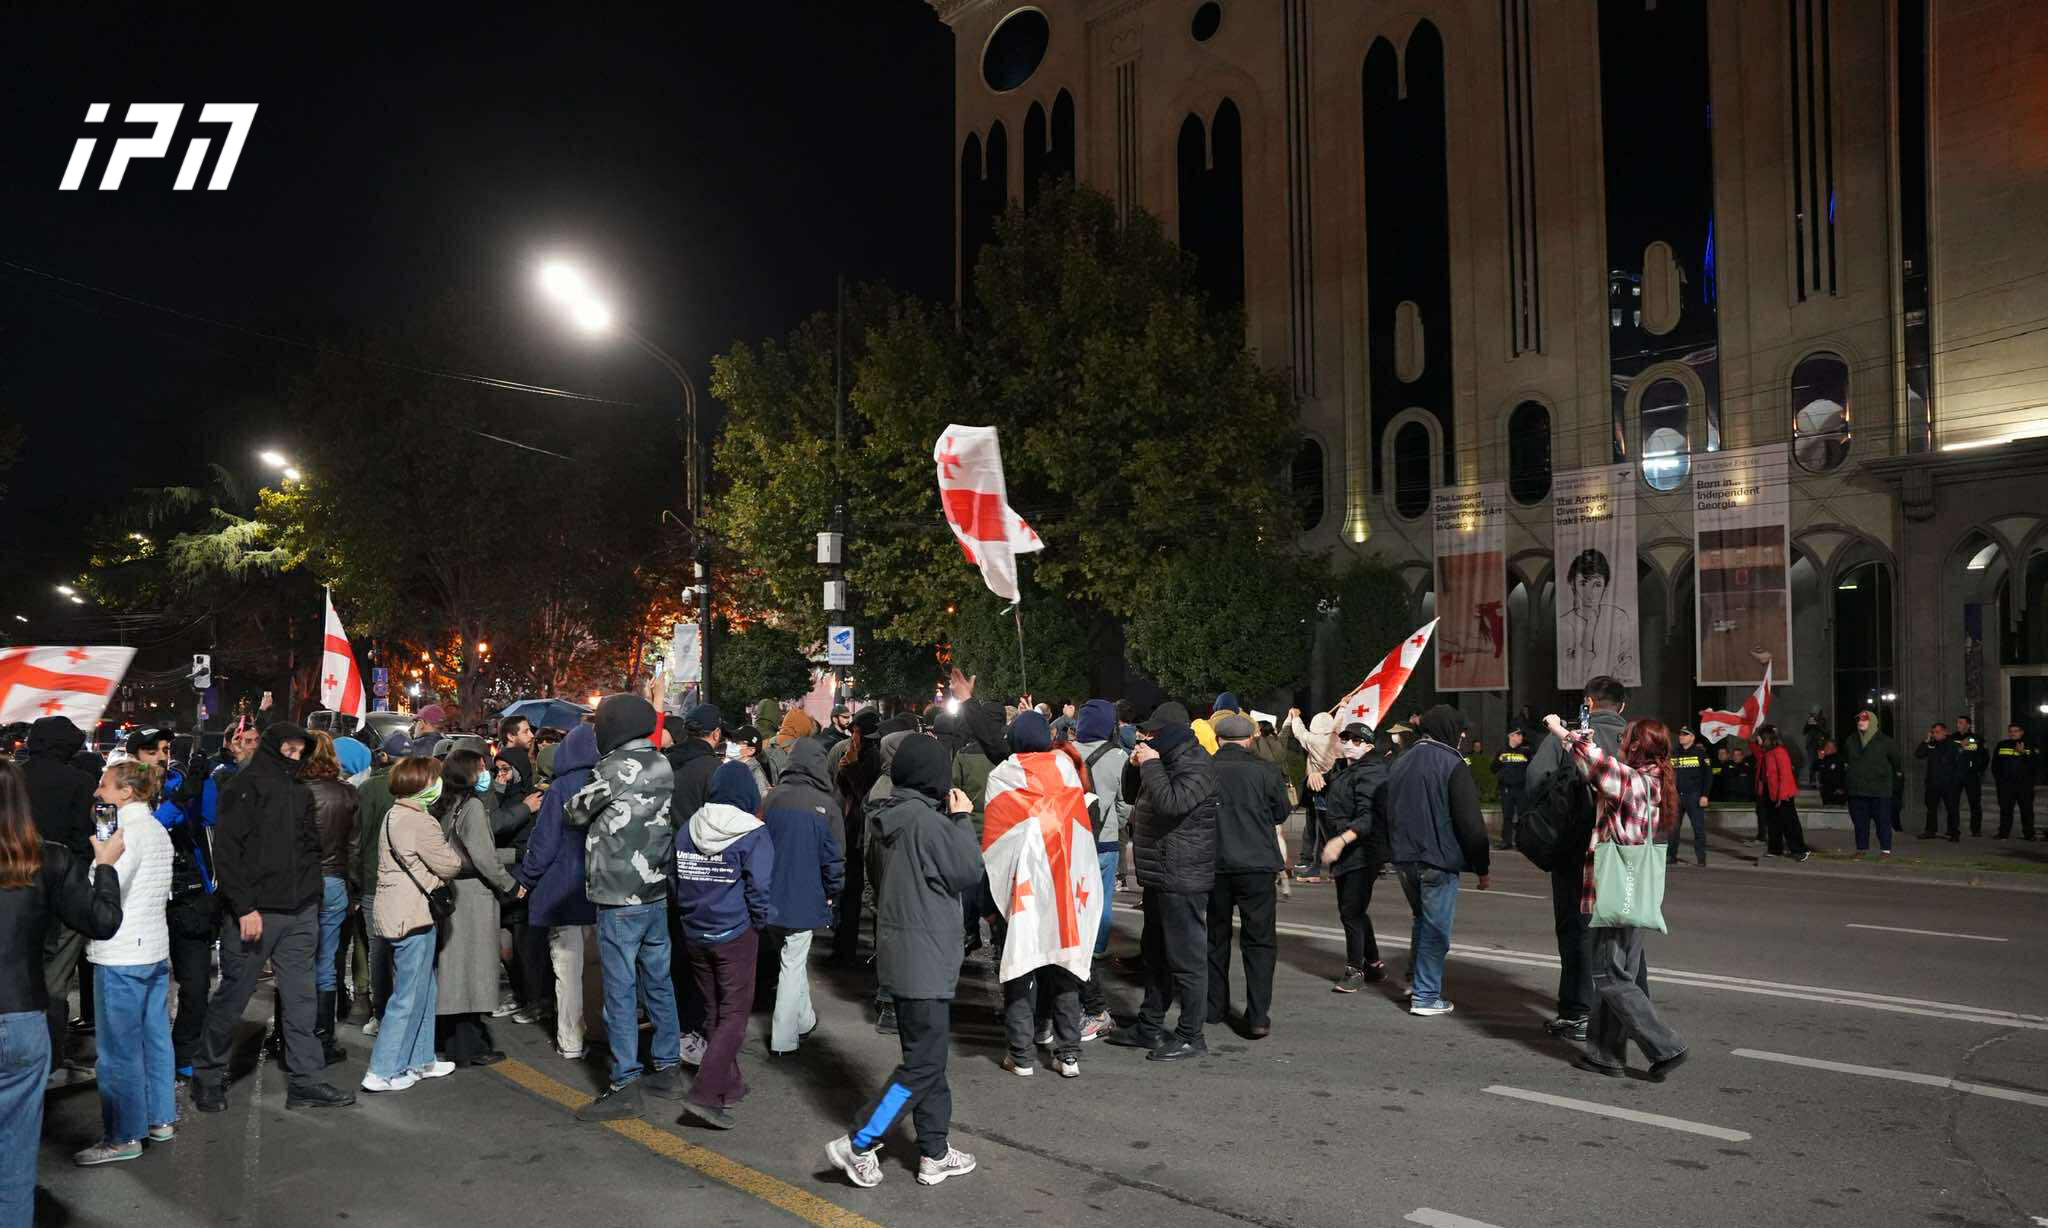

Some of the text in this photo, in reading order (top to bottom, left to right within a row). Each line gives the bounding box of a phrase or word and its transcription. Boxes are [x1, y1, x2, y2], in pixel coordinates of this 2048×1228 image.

[1697, 480, 1720, 489] Born
[1697, 486, 1760, 499] Independent
[1575, 494, 1608, 504] Artistic
[1556, 503, 1607, 515] Diversity of
[1698, 500, 1736, 510] Georgia
[1489, 507, 1502, 515] Art
[1444, 521, 1478, 530] Georga
